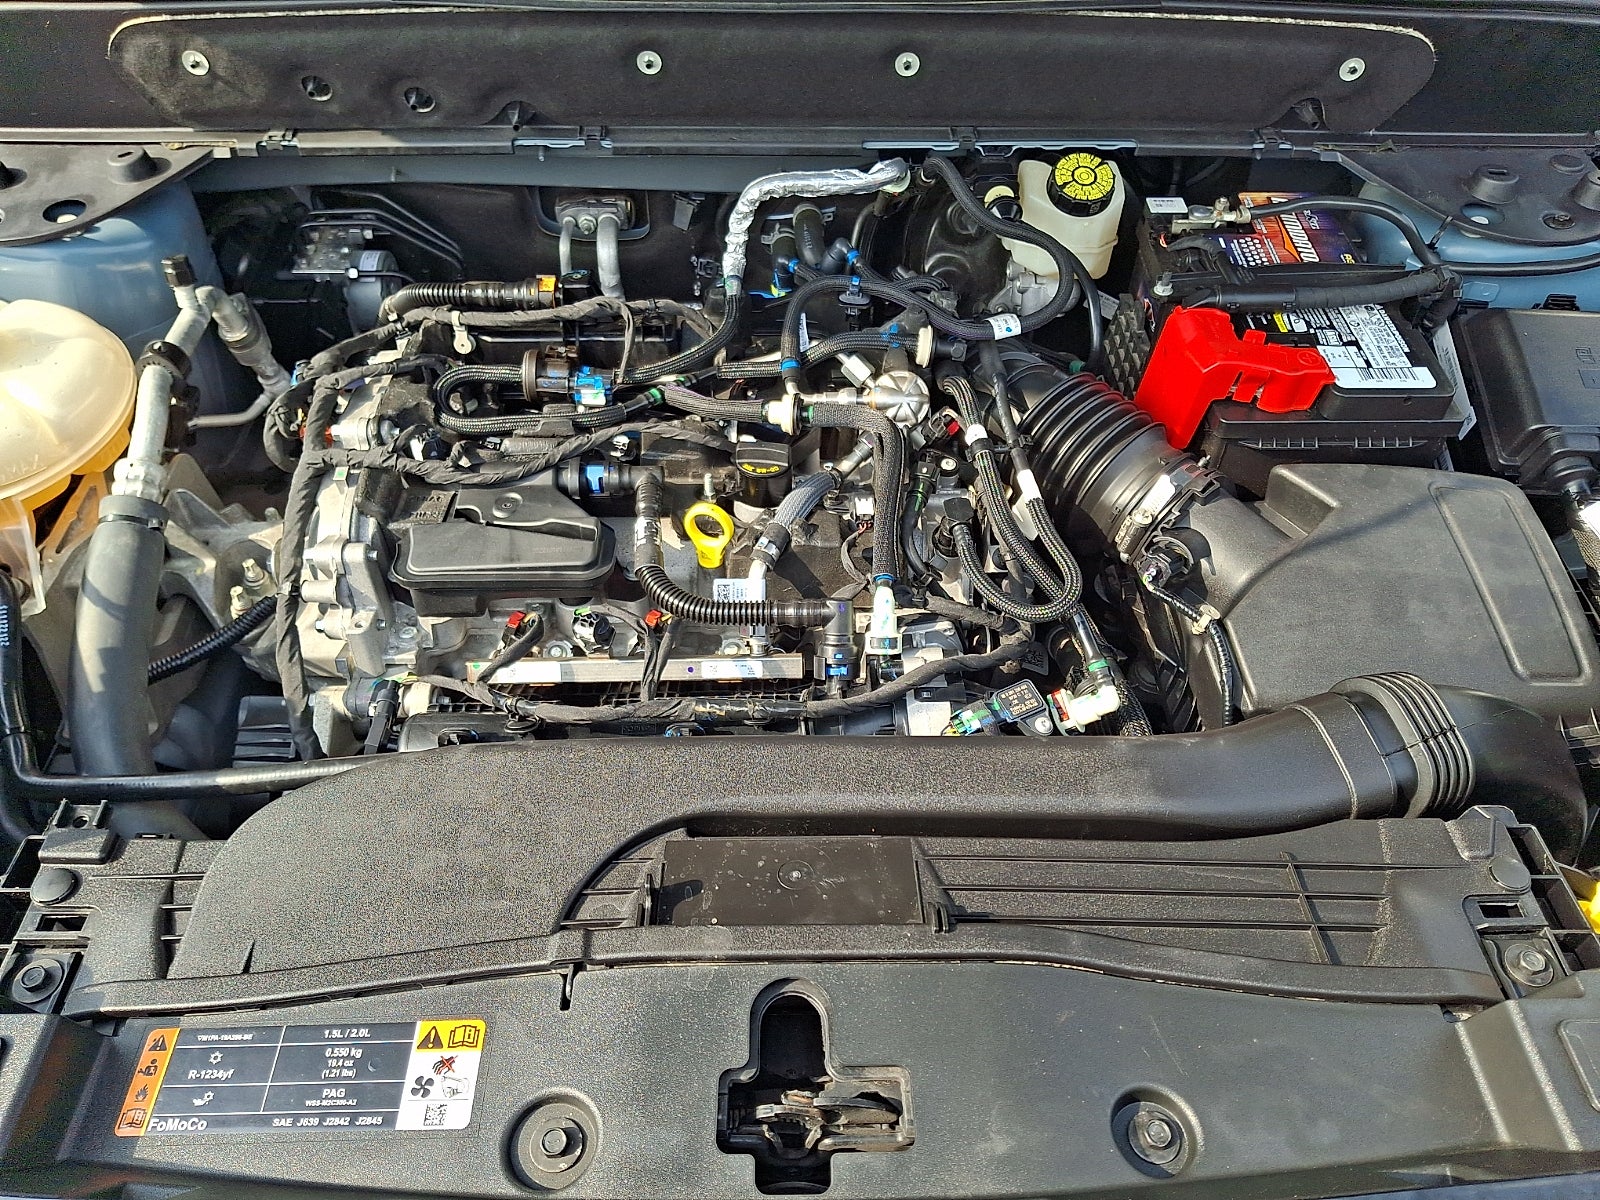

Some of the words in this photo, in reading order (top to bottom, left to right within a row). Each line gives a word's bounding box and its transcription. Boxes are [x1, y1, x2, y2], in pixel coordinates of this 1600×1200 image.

[324, 1029, 344, 1039] 1.5L
[350, 1028, 371, 1038] 2.0L
[325, 1047, 350, 1058] 0.550
[350, 1047, 363, 1059] kg
[327, 1059, 344, 1068] 19.4
[187, 1068, 235, 1081] R-1234yf
[322, 1088, 346, 1099] PAG
[147, 1117, 208, 1132] FoMoCo
[272, 1118, 294, 1127] SAE
[296, 1117, 320, 1127] J639
[322, 1116, 351, 1126] J2842
[354, 1116, 383, 1126] J2845
